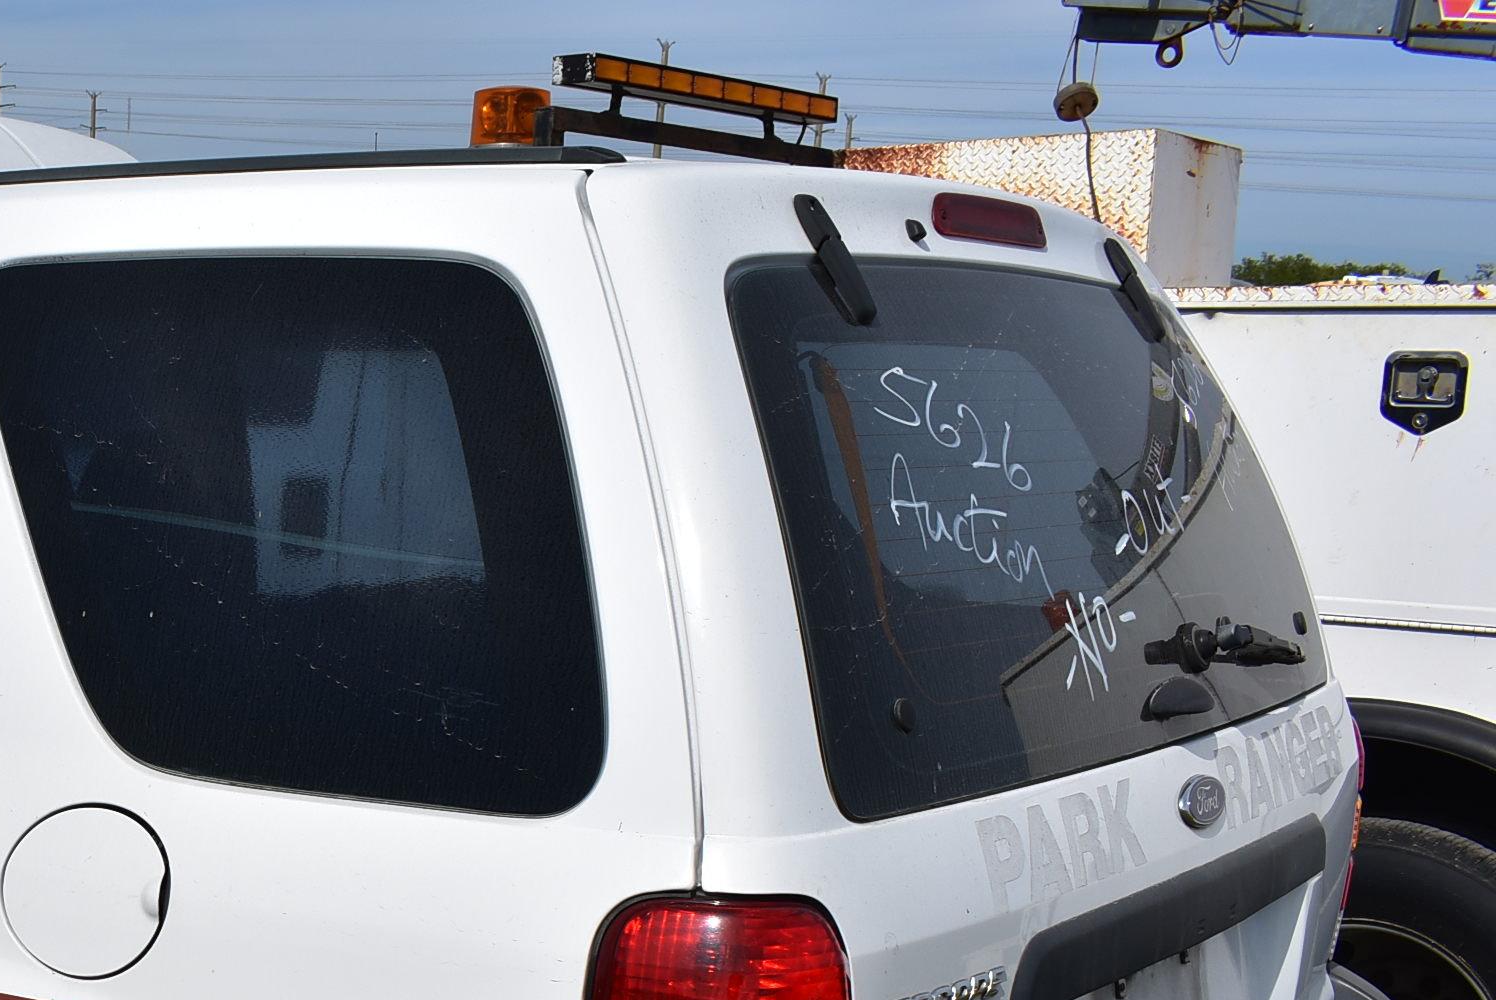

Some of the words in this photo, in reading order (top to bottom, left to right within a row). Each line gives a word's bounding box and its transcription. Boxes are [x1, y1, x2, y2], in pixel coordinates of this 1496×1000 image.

[890, 453, 1055, 601] Auction
[975, 777, 1147, 914] PARK
[1215, 704, 1344, 831] RANGER
[1196, 785, 1219, 816] Ford
